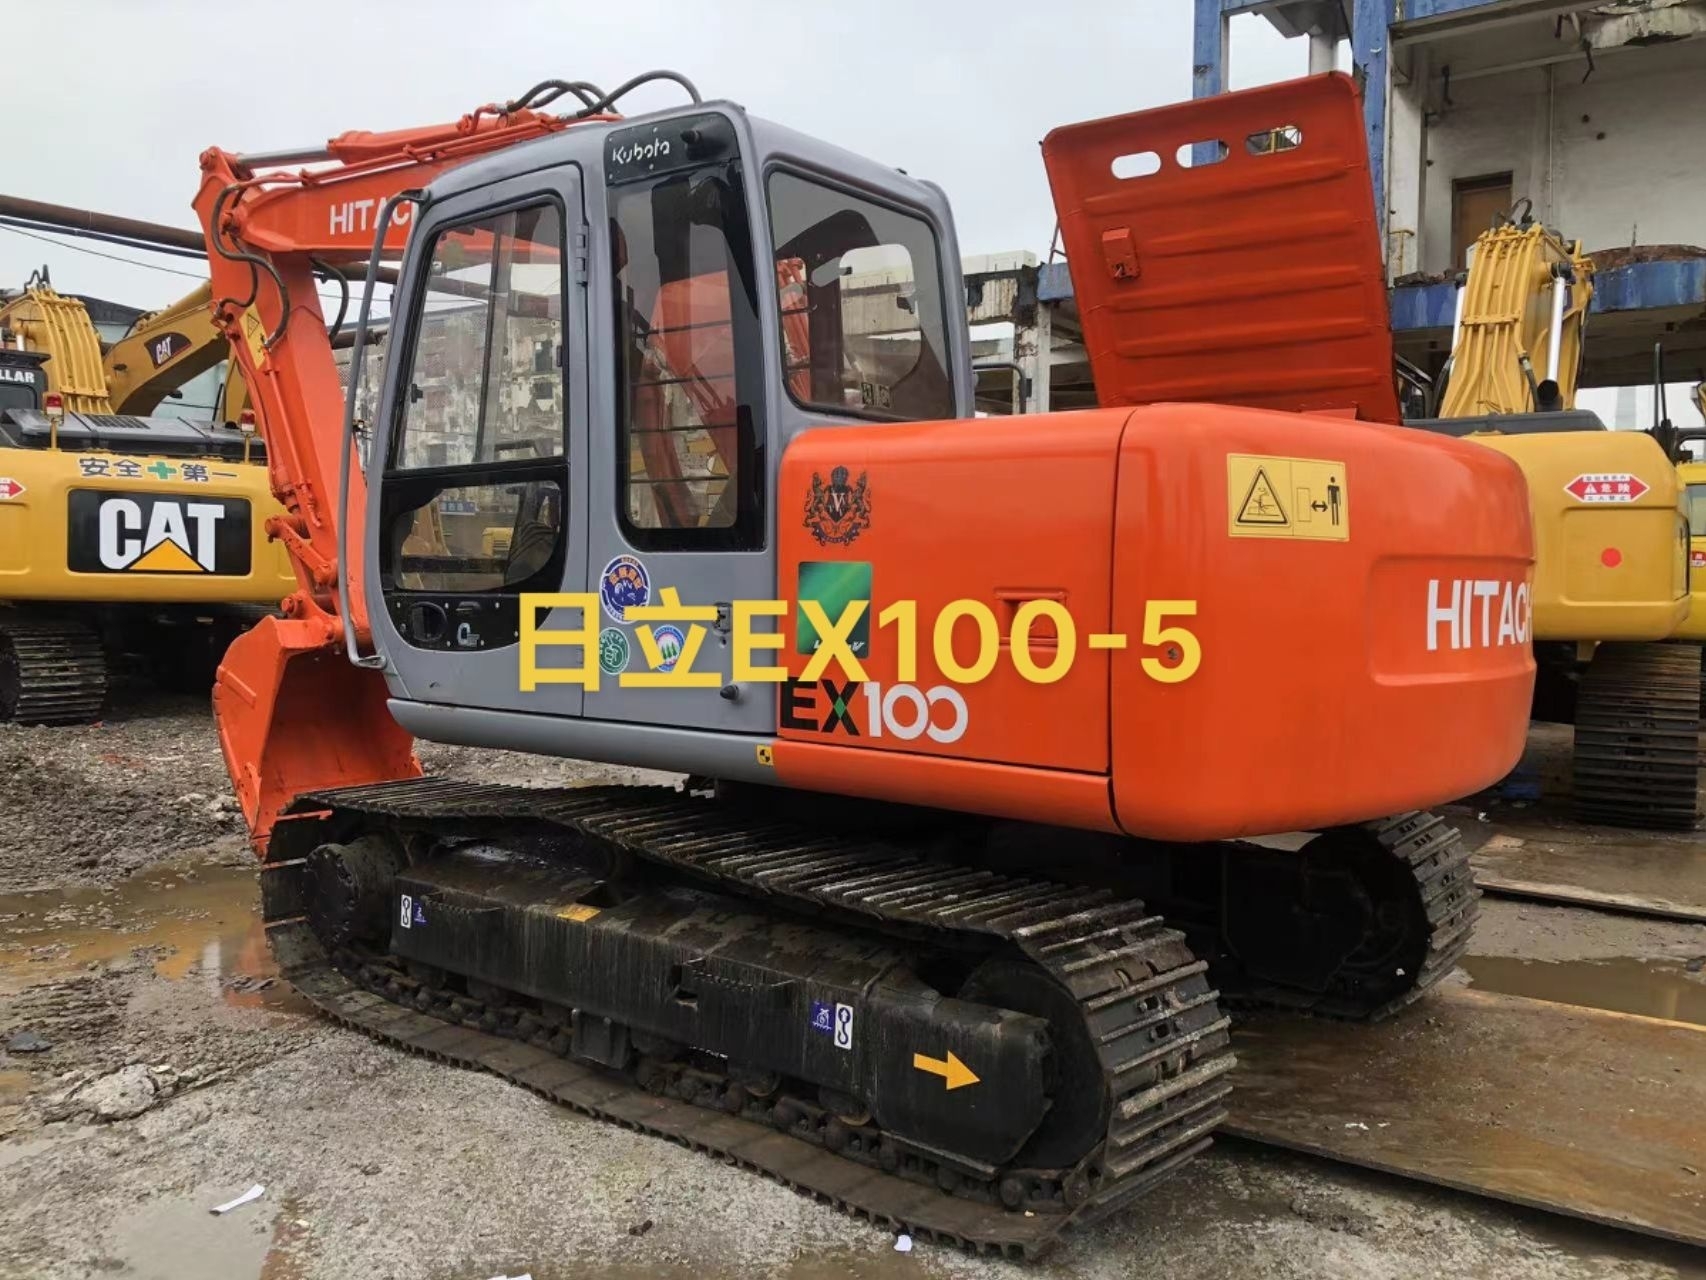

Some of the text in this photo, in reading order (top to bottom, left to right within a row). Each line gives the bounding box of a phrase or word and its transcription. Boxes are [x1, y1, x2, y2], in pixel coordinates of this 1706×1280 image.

[612, 138, 670, 164] Kubota
[329, 197, 419, 235] HITAC
[156, 336, 172, 364] CAT
[79, 457, 238, 482] 安全 第一
[100, 498, 225, 573] CAT
[780, 676, 969, 744] EX100
